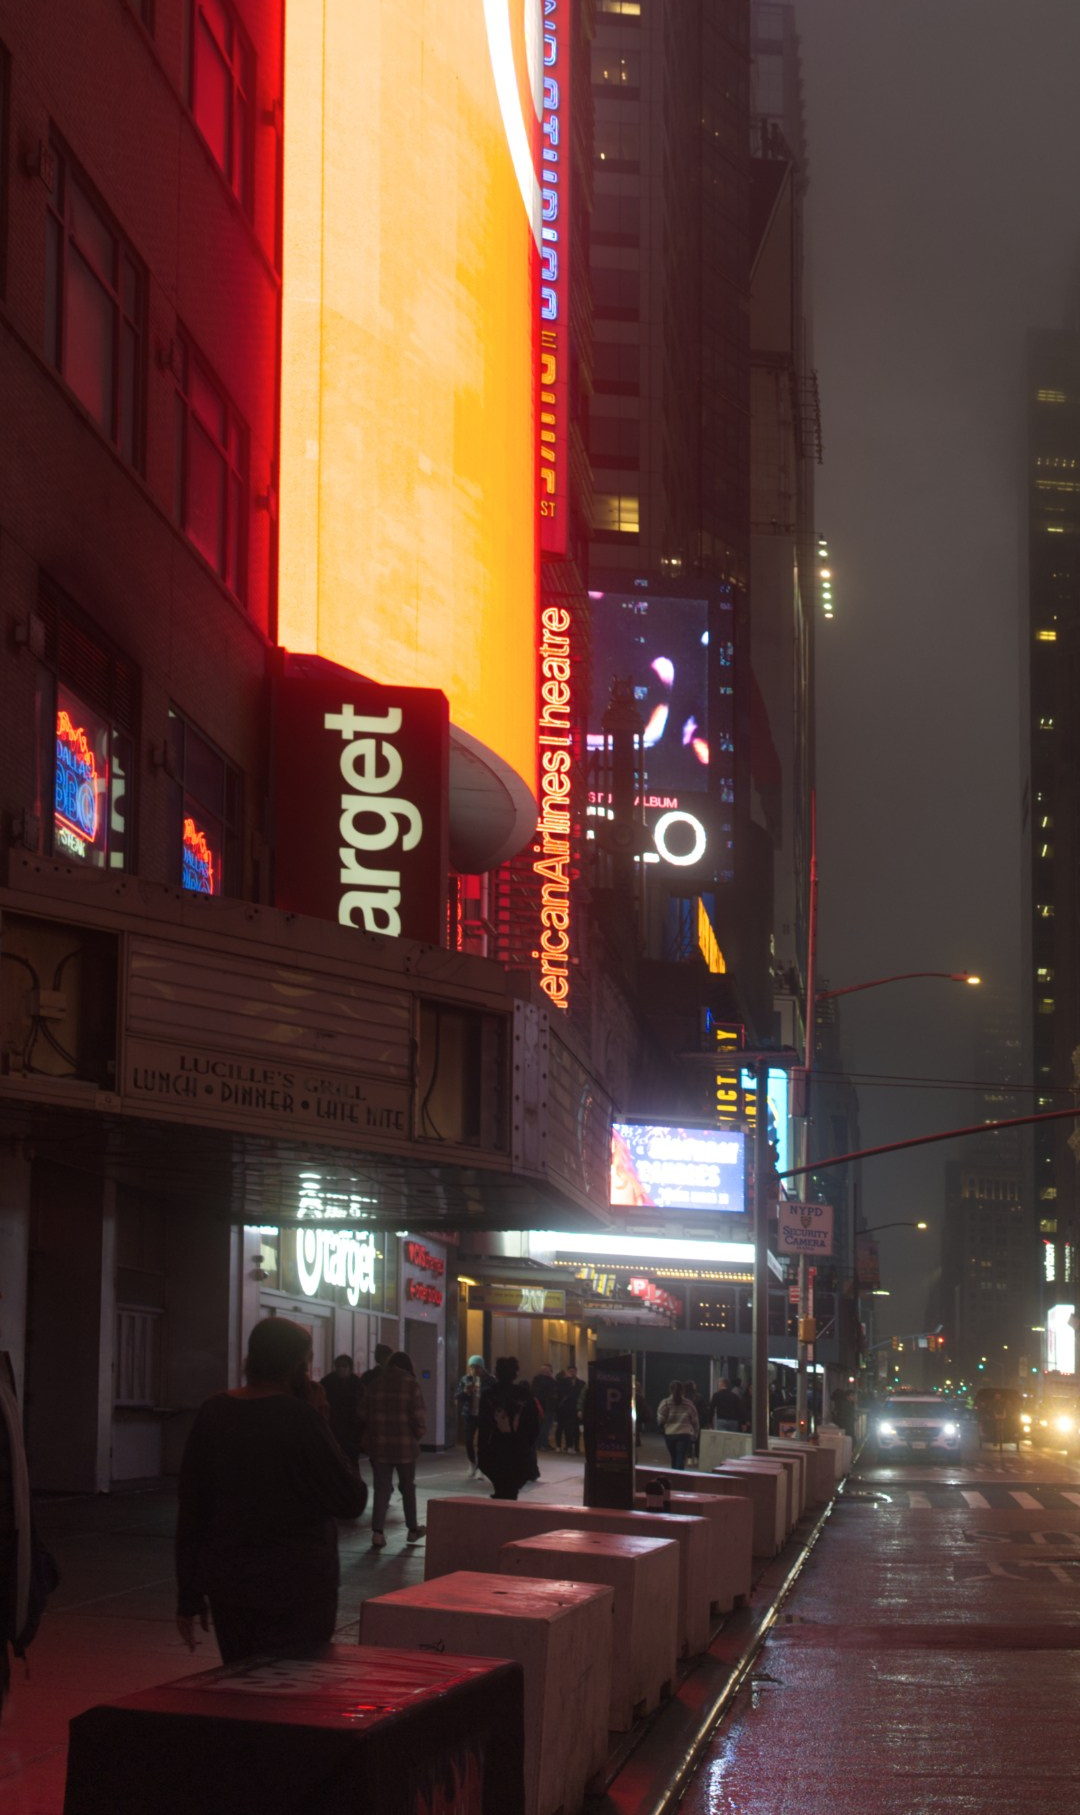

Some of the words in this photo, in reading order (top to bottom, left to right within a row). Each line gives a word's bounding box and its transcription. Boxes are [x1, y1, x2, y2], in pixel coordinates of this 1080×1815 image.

[179, 1055, 295, 1087] LUCILLE'S
[304, 1079, 367, 1102] GRILL
[133, 1067, 198, 1099] LUNCH
[220, 1081, 295, 1114] DINNER
[315, 1095, 360, 1124] LATE
[366, 1106, 405, 1132] NITE
[789, 1205, 823, 1217] NYPD
[783, 1225, 828, 1239] SECURITY
[785, 1236, 826, 1248] CAMERA
[323, 1231, 376, 1307] target
